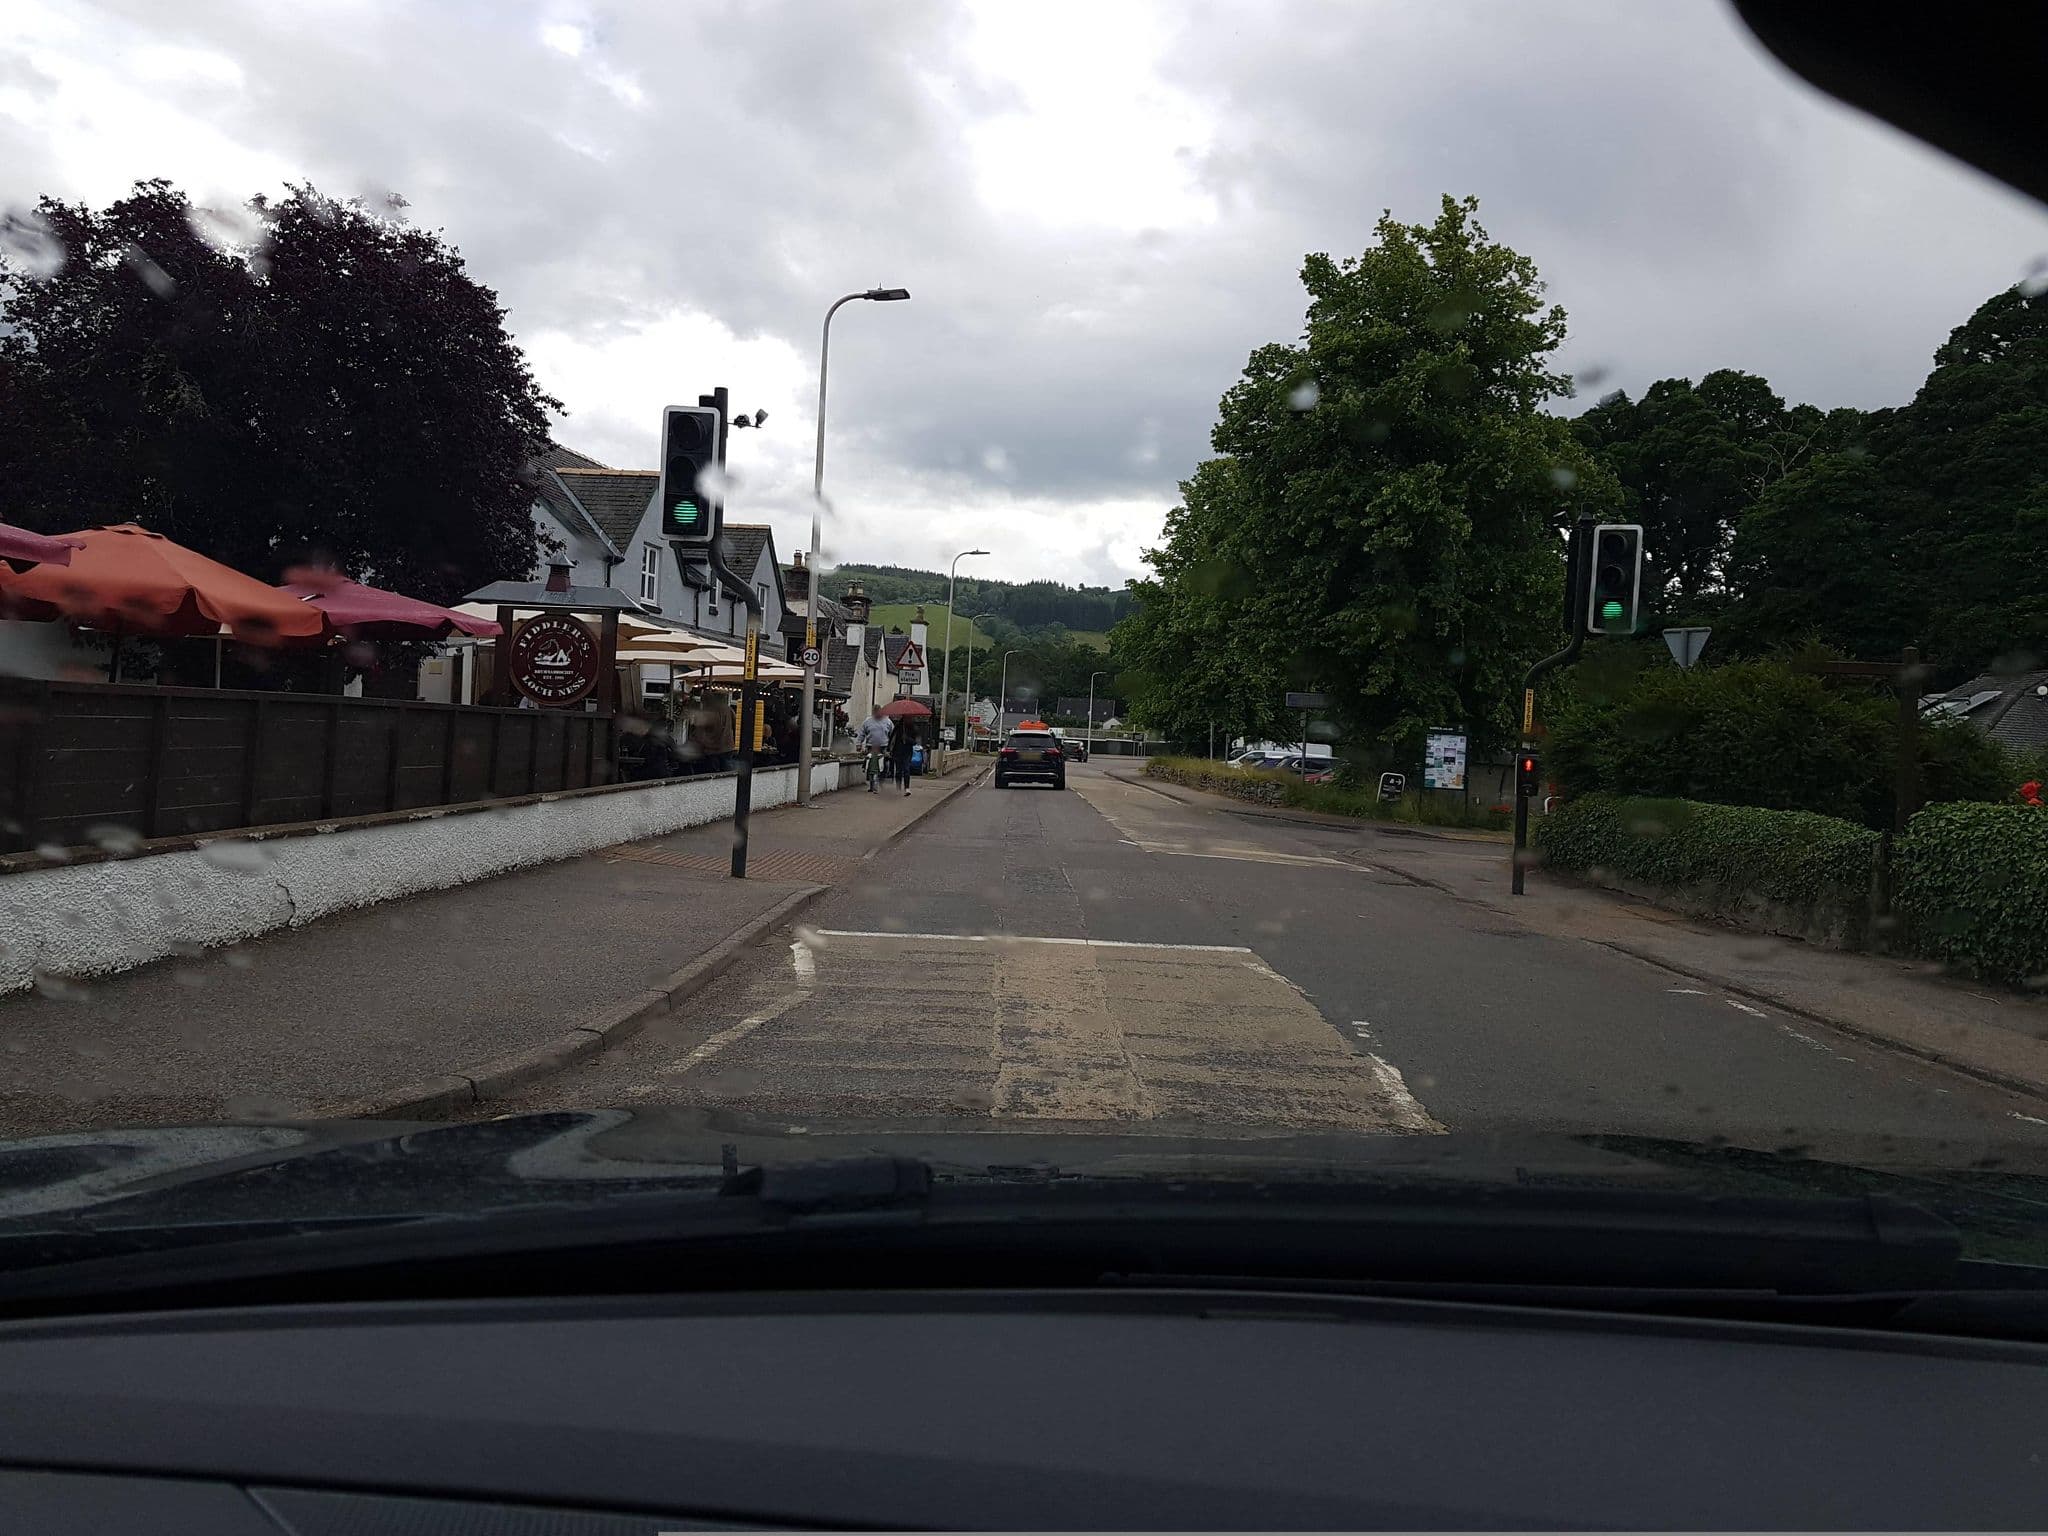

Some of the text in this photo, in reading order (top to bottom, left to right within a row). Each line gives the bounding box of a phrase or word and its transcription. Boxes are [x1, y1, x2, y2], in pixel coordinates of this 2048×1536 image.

[804, 652, 819, 661] 20
[522, 675, 586, 696] LOCH NESS
